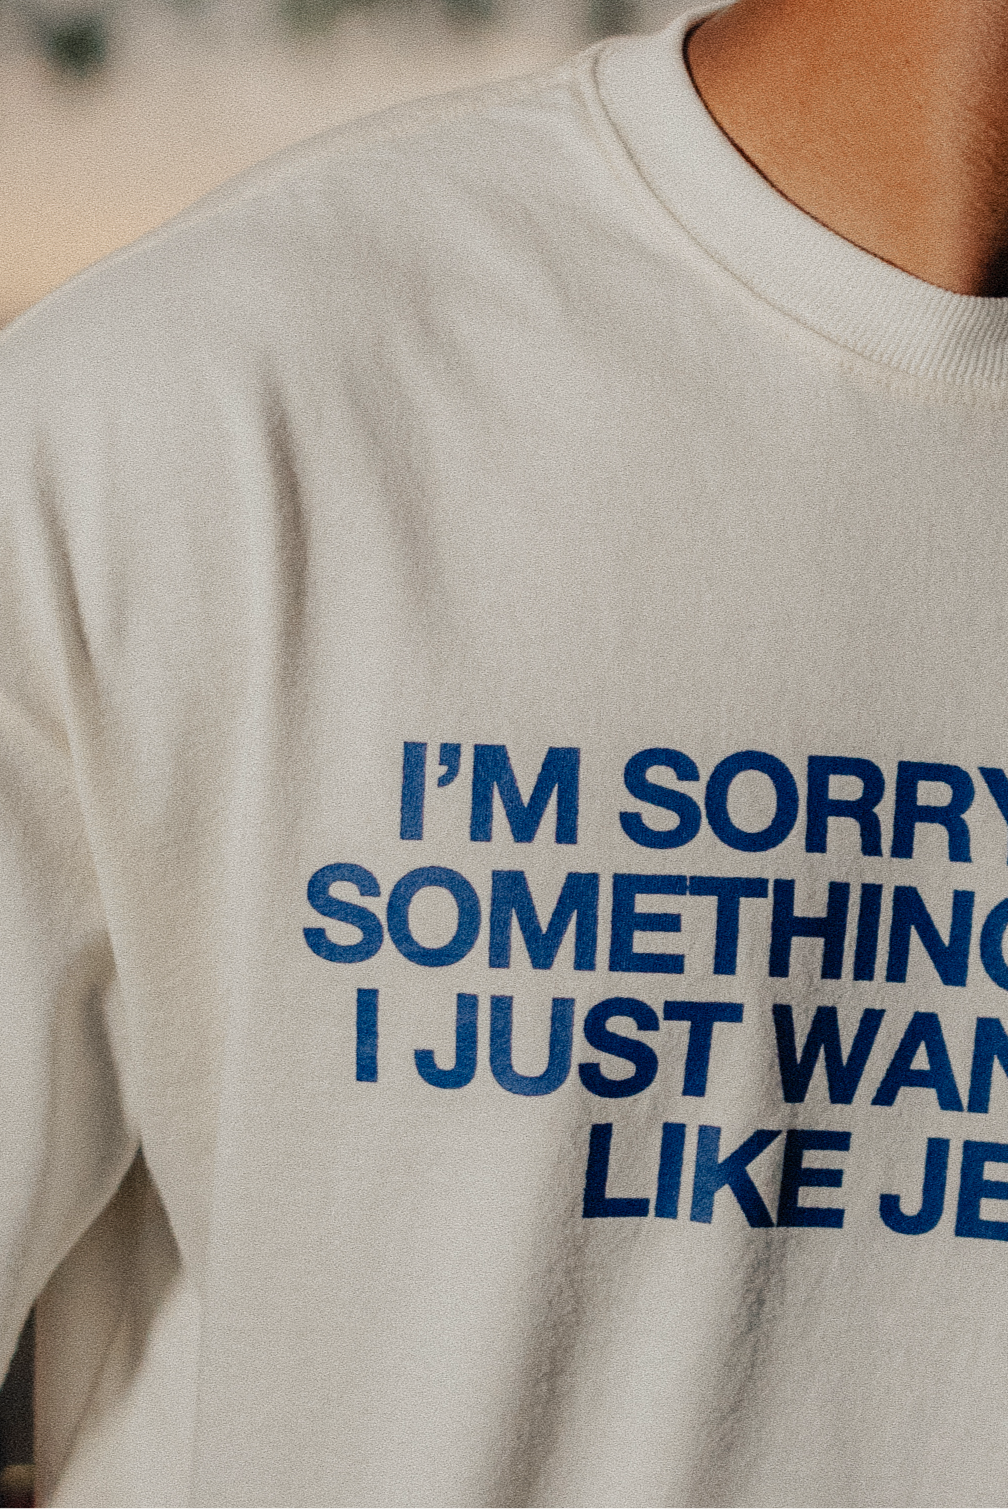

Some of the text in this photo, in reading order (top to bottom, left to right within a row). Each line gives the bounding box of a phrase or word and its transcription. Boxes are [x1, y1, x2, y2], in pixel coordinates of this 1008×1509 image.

[400, 741, 581, 846] I'M
[354, 987, 380, 1084] I
[413, 992, 744, 1099] JUST
[582, 1121, 853, 1229] LIKE
